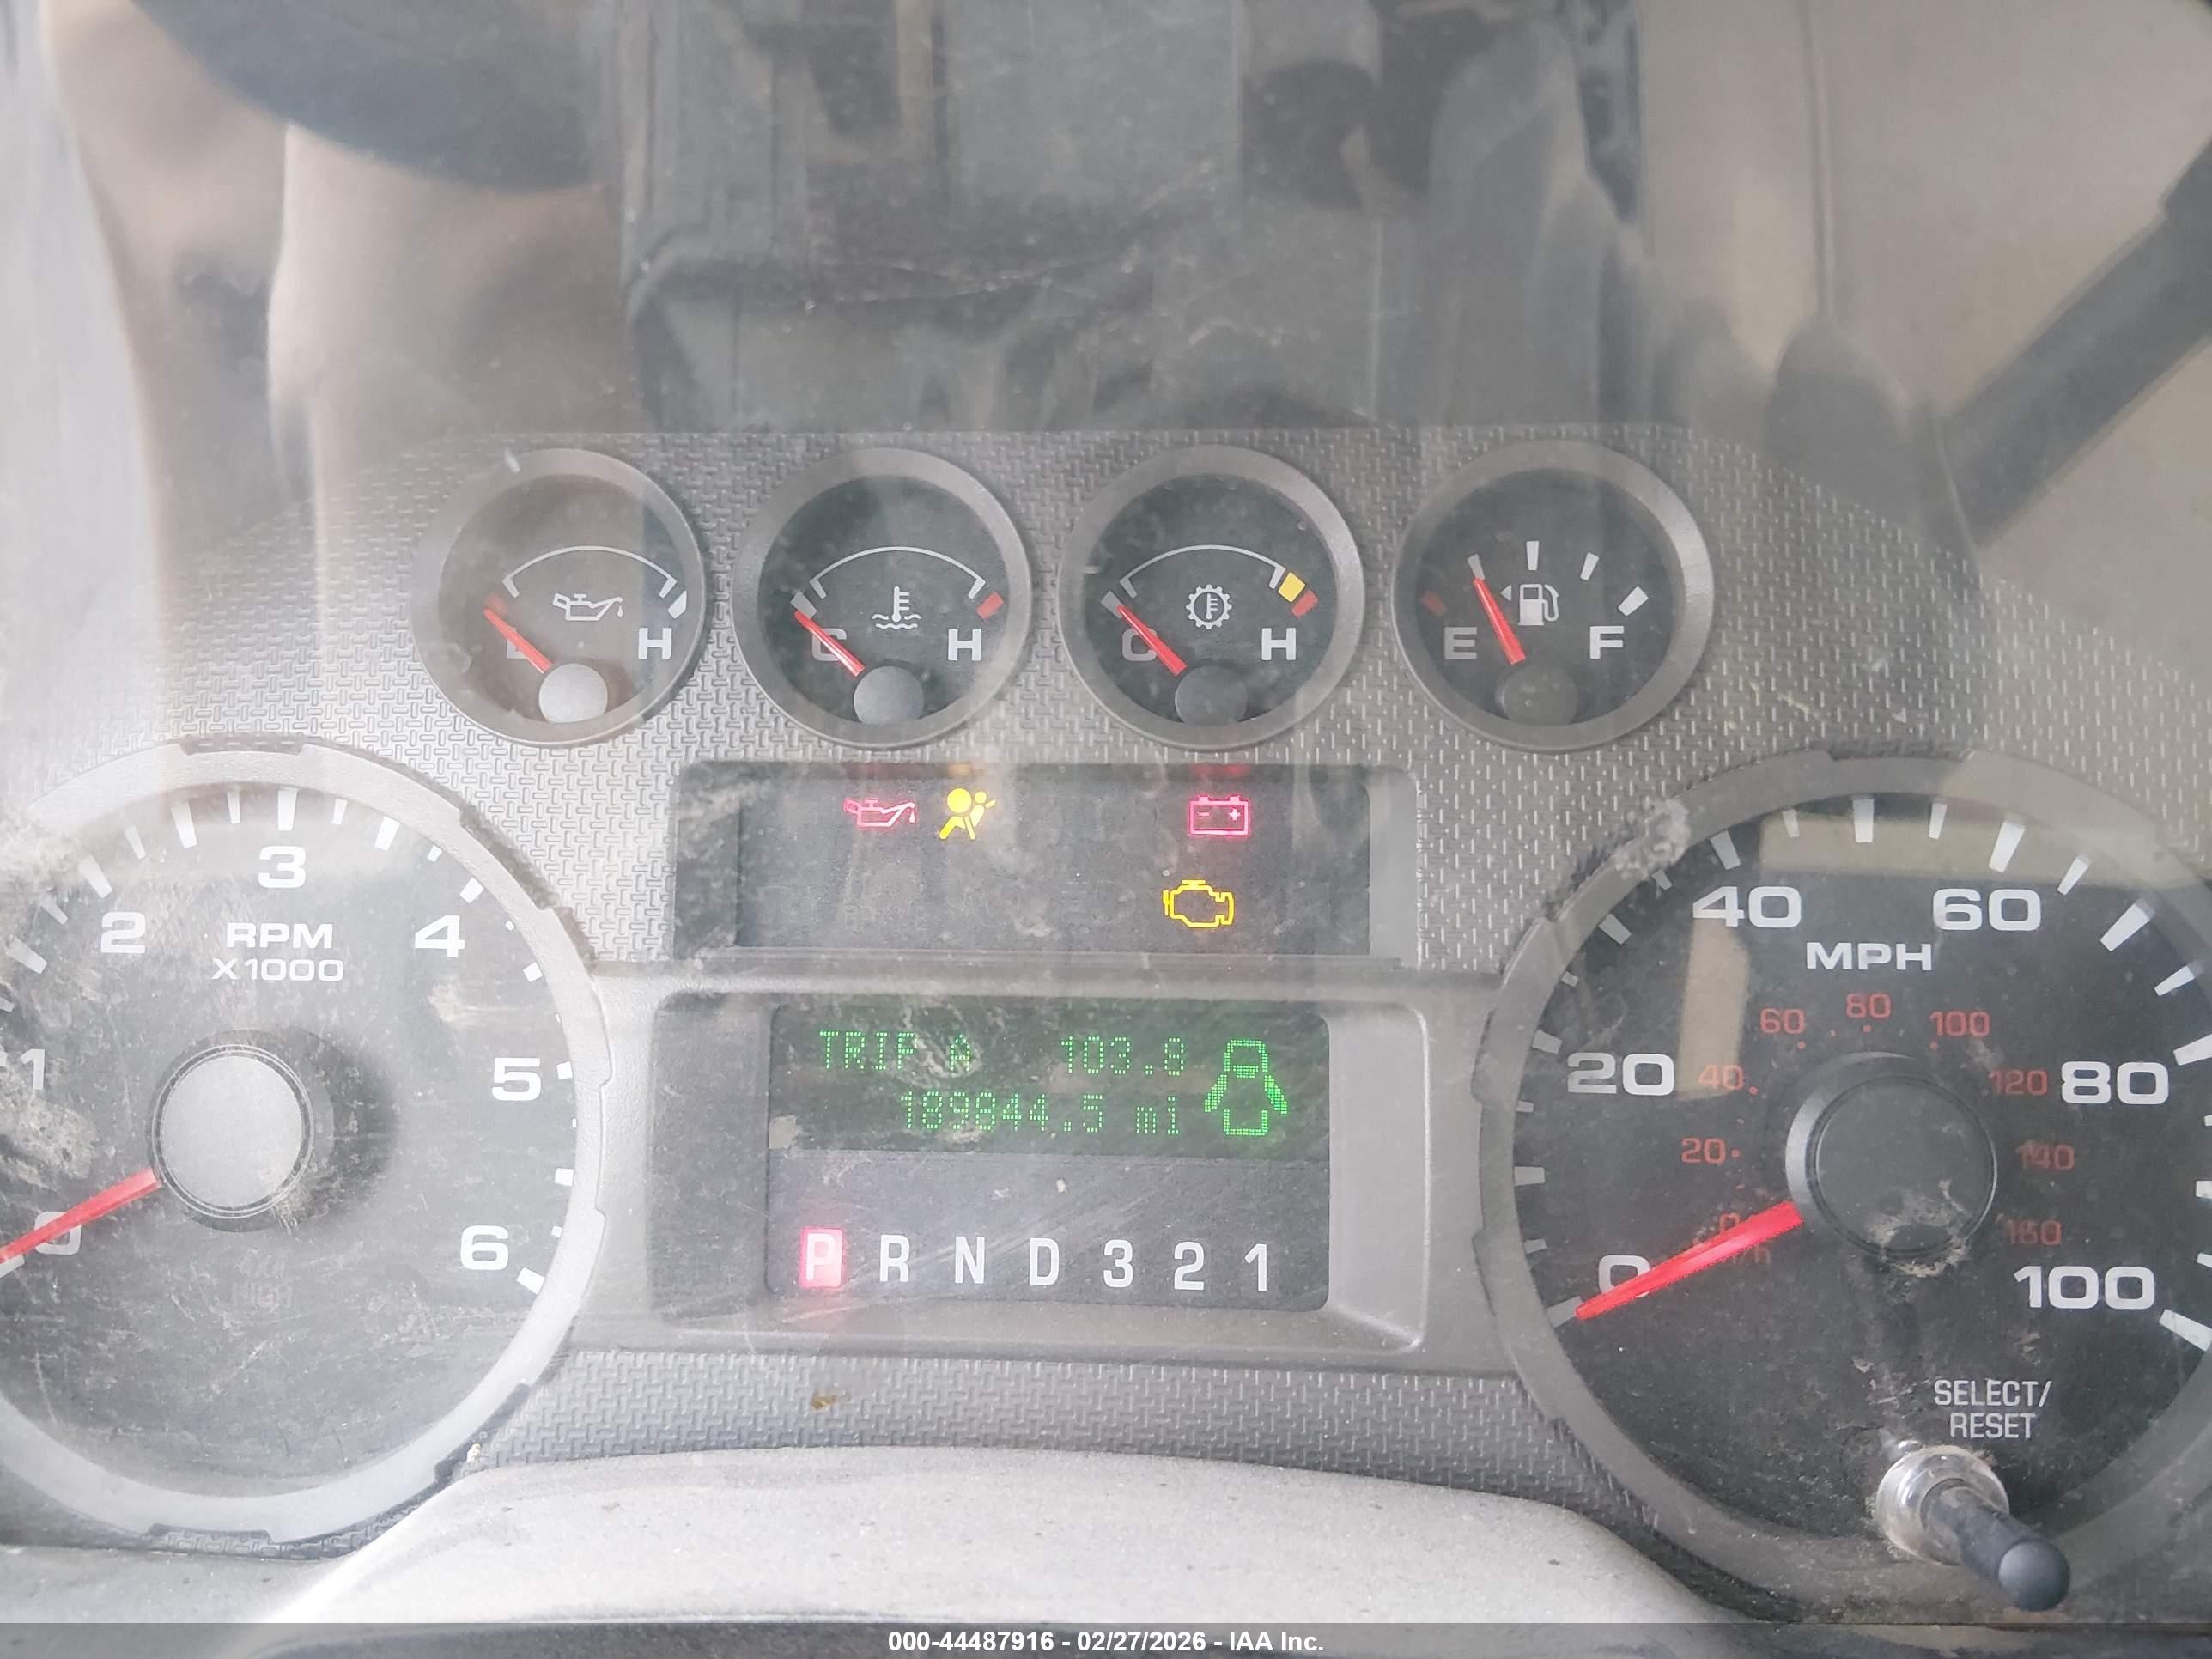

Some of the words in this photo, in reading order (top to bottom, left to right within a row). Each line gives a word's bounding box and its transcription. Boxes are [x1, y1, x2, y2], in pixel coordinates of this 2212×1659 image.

[638, 628, 672, 659] H
[812, 628, 848, 661] C
[948, 629, 982, 661] H
[1122, 628, 1158, 661] C
[1261, 628, 1297, 660] H
[1443, 627, 1477, 659] E
[1589, 627, 1625, 659] F
[258, 846, 307, 888] 3
[1692, 886, 1802, 928] 40
[1933, 889, 2041, 932] 60
[101, 912, 146, 953] 2
[226, 923, 333, 949] RPM
[414, 915, 465, 957] 4
[1807, 942, 1932, 971] MPH
[1760, 1008, 1805, 1035] 60
[1846, 993, 1891, 1018] 80
[1929, 1011, 1990, 1037] 100
[20, 1048, 45, 1091] 1
[819, 1030, 920, 1070] TRIP
[950, 1034, 970, 1072] A
[1061, 1036, 1184, 1076] 103.8
[492, 1058, 541, 1101] 5
[1567, 1053, 1674, 1097] 20
[1698, 1064, 1744, 1091] 40
[1989, 1069, 2048, 1096] 120
[2061, 1061, 2169, 1105] 80
[901, 1091, 1103, 1133] 189844.5
[1137, 1096, 1179, 1134] mi
[1681, 1137, 1726, 1164] 20
[35, 1211, 82, 1255] 0
[460, 1225, 508, 1270] 6
[805, 1233, 837, 1280] P
[880, 1235, 909, 1283] R
[955, 1237, 987, 1284] N
[1030, 1237, 1060, 1285] D
[1103, 1241, 1134, 1289] 3
[1174, 1243, 1206, 1291] 2
[1244, 1244, 1267, 1292] 1
[1598, 1255, 1650, 1297] 0
[2014, 1266, 2155, 1310] 100
[1934, 1378, 2051, 1408] SELECT/
[1949, 1412, 2036, 1440] RESET
